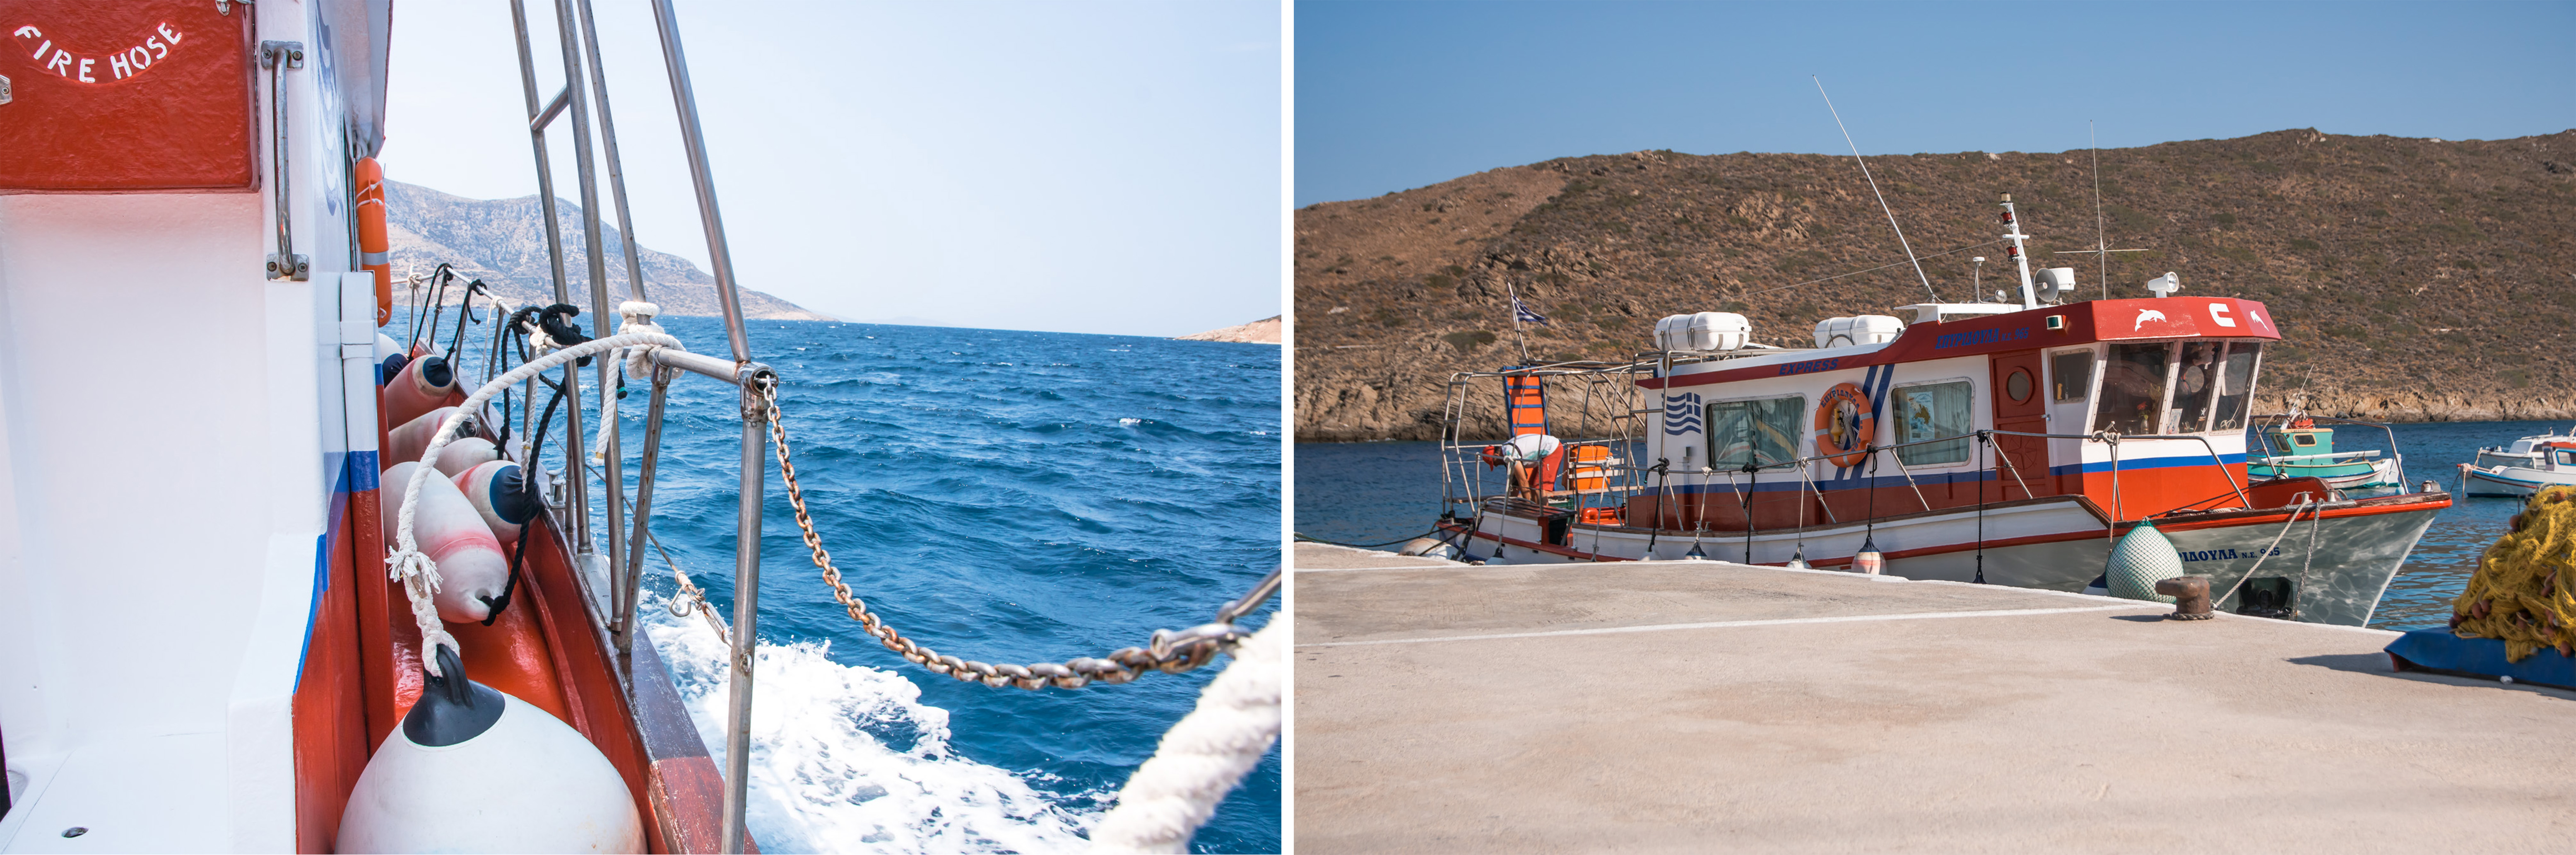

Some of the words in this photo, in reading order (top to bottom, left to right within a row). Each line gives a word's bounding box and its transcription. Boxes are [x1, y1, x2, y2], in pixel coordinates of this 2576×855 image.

[14, 25, 96, 83] FIRE
[110, 22, 182, 79] HOSE
[1935, 328, 1999, 349] ΣΠΥΡΙΔΟΥΛΑ
[2014, 327, 2030, 340] 965
[1779, 358, 1839, 375] EXPRESS
